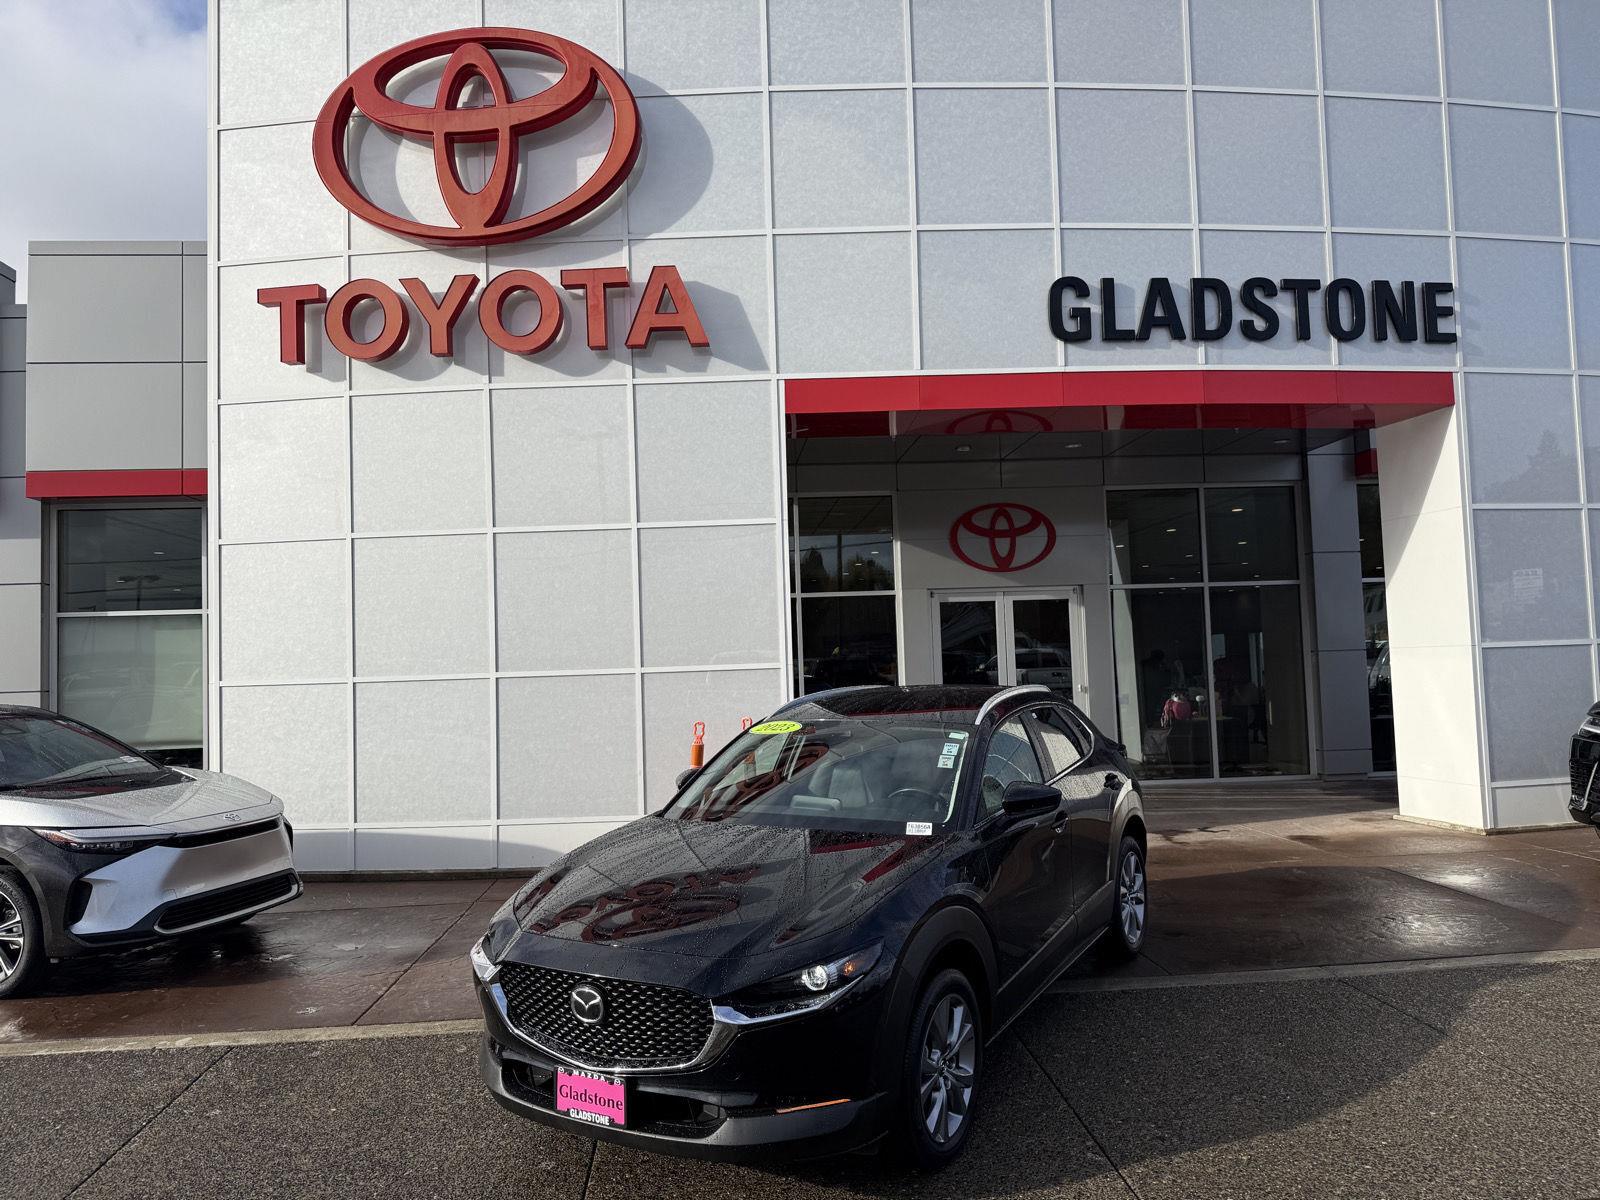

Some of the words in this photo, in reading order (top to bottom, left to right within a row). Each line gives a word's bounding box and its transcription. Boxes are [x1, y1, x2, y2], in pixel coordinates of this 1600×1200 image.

[257, 265, 709, 365] TOYOTA
[1048, 276, 1457, 344] GLADSTONE
[572, 1070, 606, 1082] MAZDA
[559, 1084, 624, 1111] Gladstone
[569, 1108, 610, 1126] GLADSTONE
